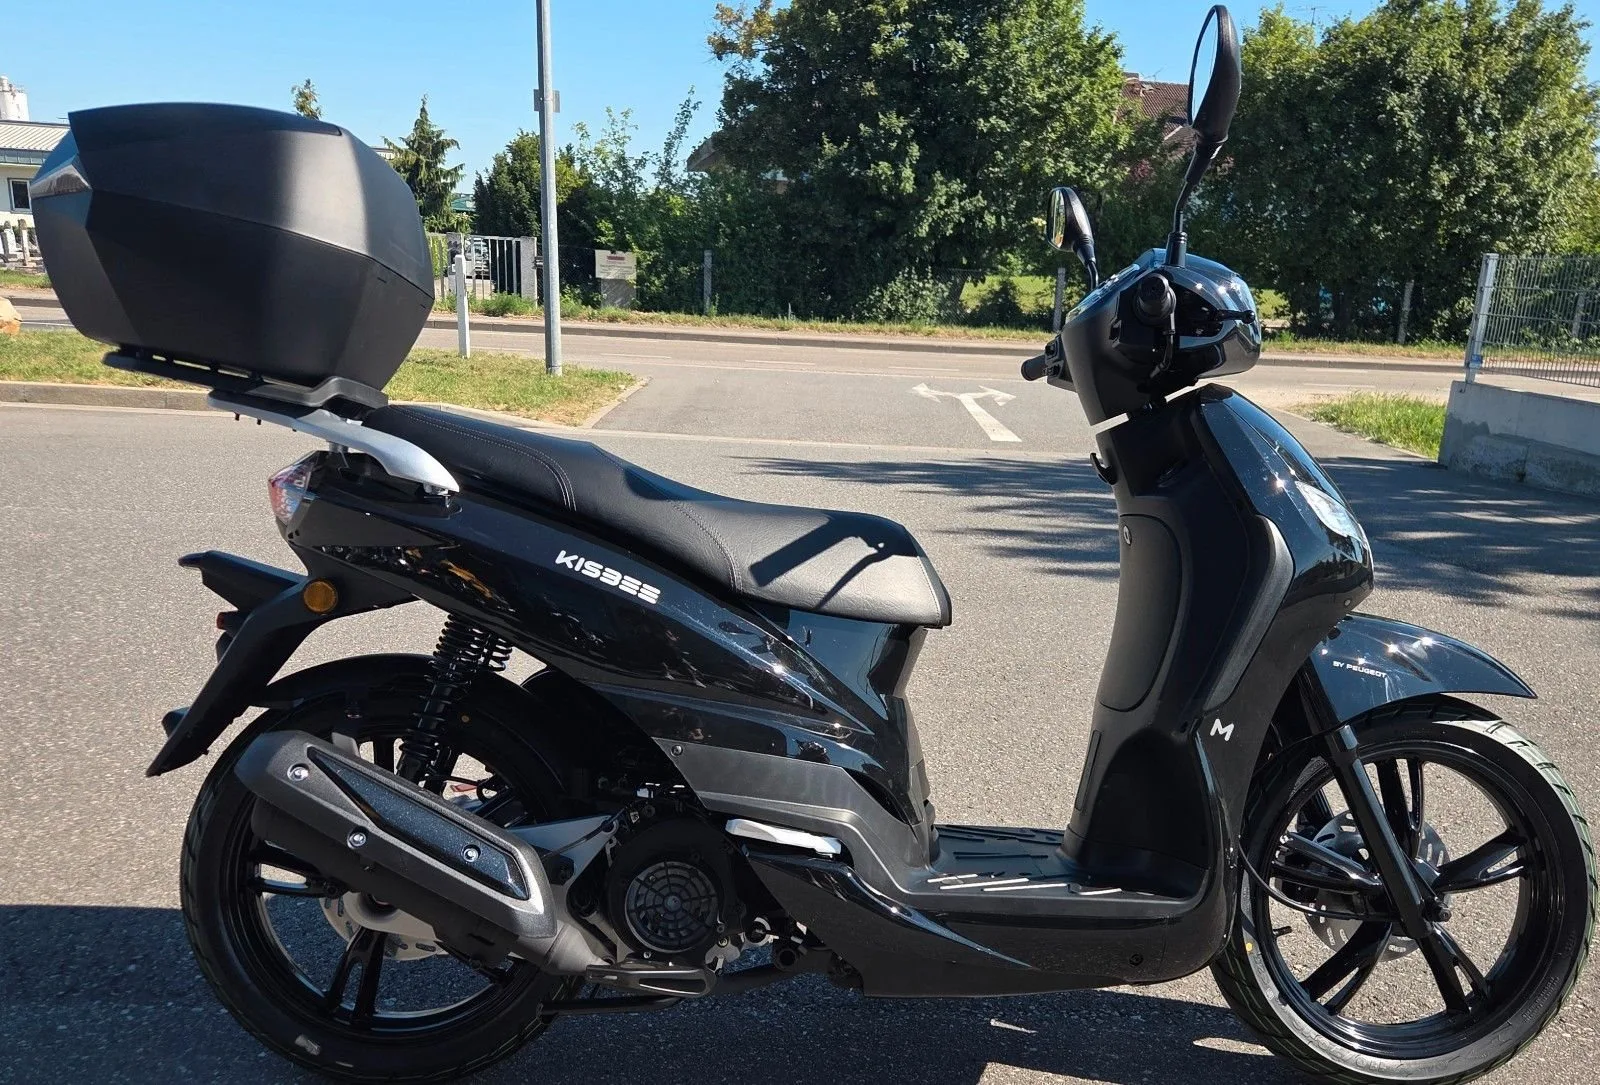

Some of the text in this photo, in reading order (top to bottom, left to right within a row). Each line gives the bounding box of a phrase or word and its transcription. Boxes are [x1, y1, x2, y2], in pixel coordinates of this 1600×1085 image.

[555, 550, 661, 604] KISBEE
[1332, 660, 1387, 678] BY PEUGEOT
[1209, 718, 1235, 742] M
